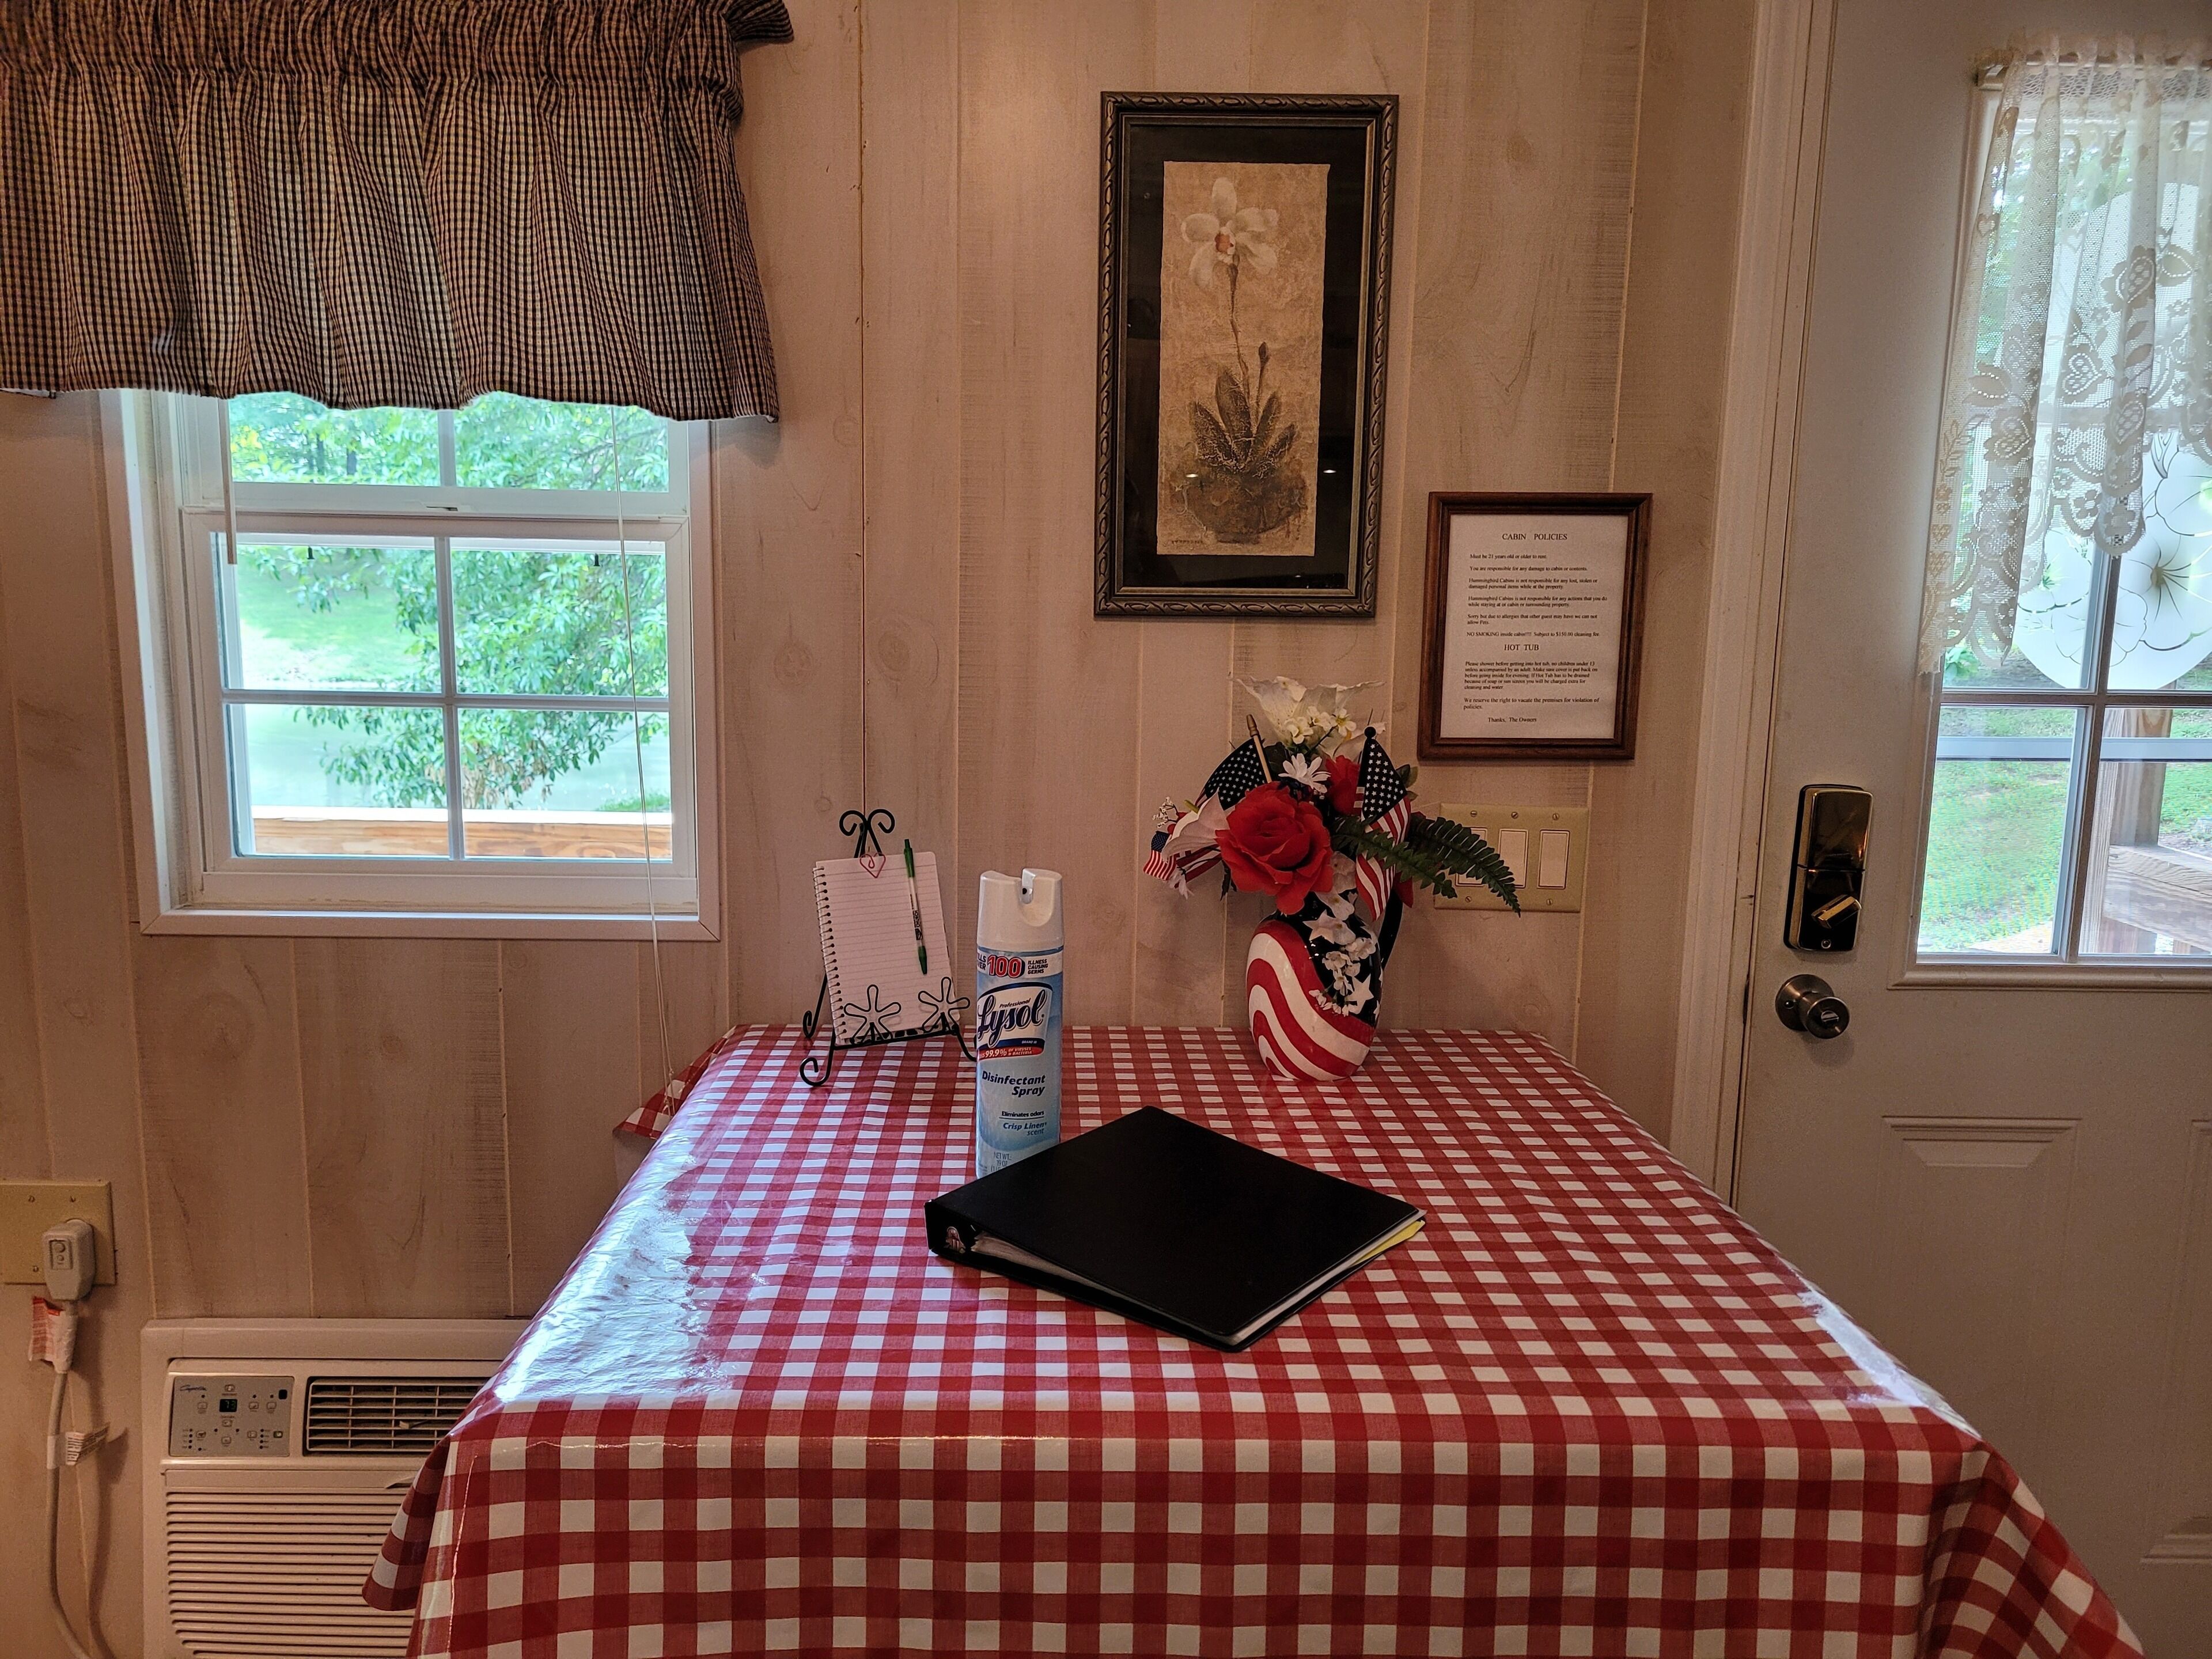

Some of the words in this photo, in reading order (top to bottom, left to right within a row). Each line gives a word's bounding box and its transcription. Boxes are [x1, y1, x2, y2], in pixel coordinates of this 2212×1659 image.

[987, 955, 1025, 978] 100
[999, 998, 1031, 1008] Professional
[978, 990, 1046, 1046] Lysol
[985, 1048, 1007, 1058] 99.9%
[982, 1070, 1046, 1085] Disinfectant
[1012, 1086, 1046, 1097] Spray
[1003, 1123, 1022, 1131] Crisp
